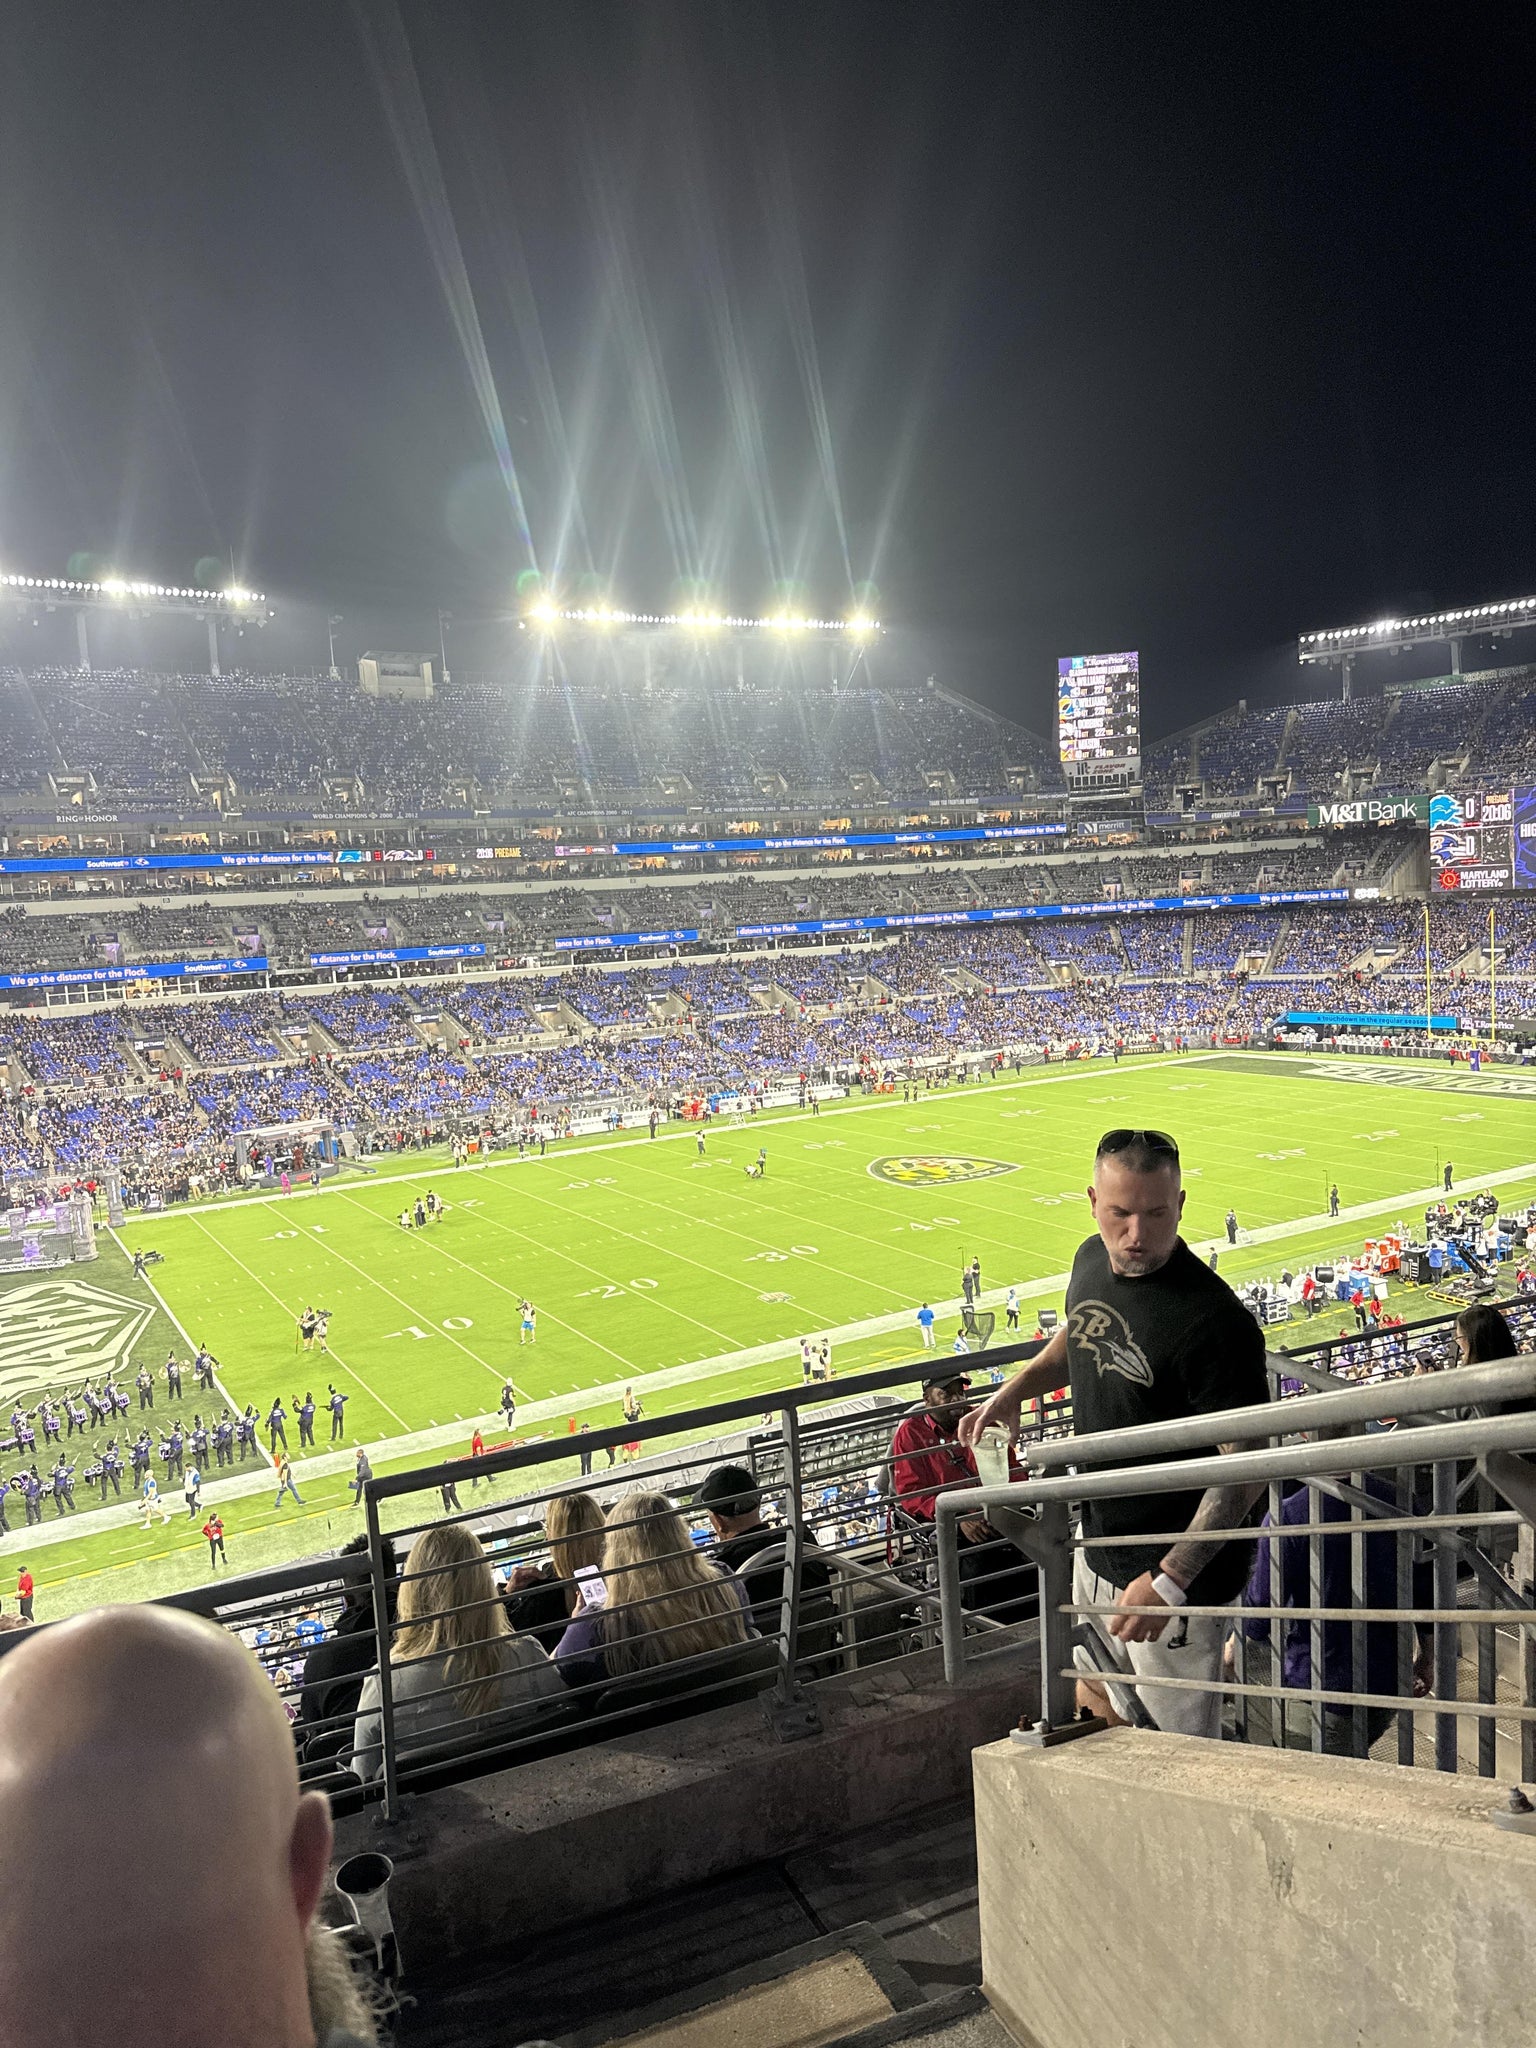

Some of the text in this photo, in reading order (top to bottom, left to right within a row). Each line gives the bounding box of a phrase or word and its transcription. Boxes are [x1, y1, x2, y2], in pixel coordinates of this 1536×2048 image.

[1463, 665, 1528, 682] HONOR ROWS
[1486, 794, 1509, 805] PREGAME
[1318, 799, 1416, 824] M&T Bank
[1465, 798, 1475, 819] 0
[1482, 804, 1512, 822] 20:06
[56, 814, 118, 823] RING HONOR
[1099, 822, 1125, 831] merritt
[1465, 836, 1475, 856] 0
[494, 847, 522, 858] PREGAME
[86, 860, 124, 868] Southwest
[222, 854, 316, 865] We go the distance for the
[1460, 869, 1509, 880] MARYLAND
[1460, 879, 1499, 888] LOTTERY
[1183, 898, 1212, 906] Southwest
[1271, 895, 1280, 903] go
[1293, 892, 1319, 900] distance
[1320, 891, 1330, 899] for
[1330, 890, 1342, 898] the
[1091, 903, 1117, 911] distance
[992, 910, 1018, 918] Southwest
[886, 917, 895, 925] We
[913, 915, 935, 923] distance
[740, 926, 763, 934] distance
[782, 924, 798, 932] Flock.
[427, 948, 459, 956] Southwest
[318, 954, 350, 964] distance
[350, 954, 362, 962] for
[184, 964, 222, 973] Southwest
[10, 968, 148, 987] We go the distance for the Flock.
[1322, 1015, 1359, 1023] touchdown
[1378, 1017, 1402, 1025] regular
[1499, 1021, 1515, 1030] Price
[1031, 1191, 1089, 1206] 50
[910, 1216, 961, 1233] 40
[274, 1224, 330, 1239] 10
[757, 1245, 819, 1263] 30
[590, 1278, 659, 1299] 20
[1084, 1308, 1112, 1338] B
[401, 1317, 474, 1341] 10
